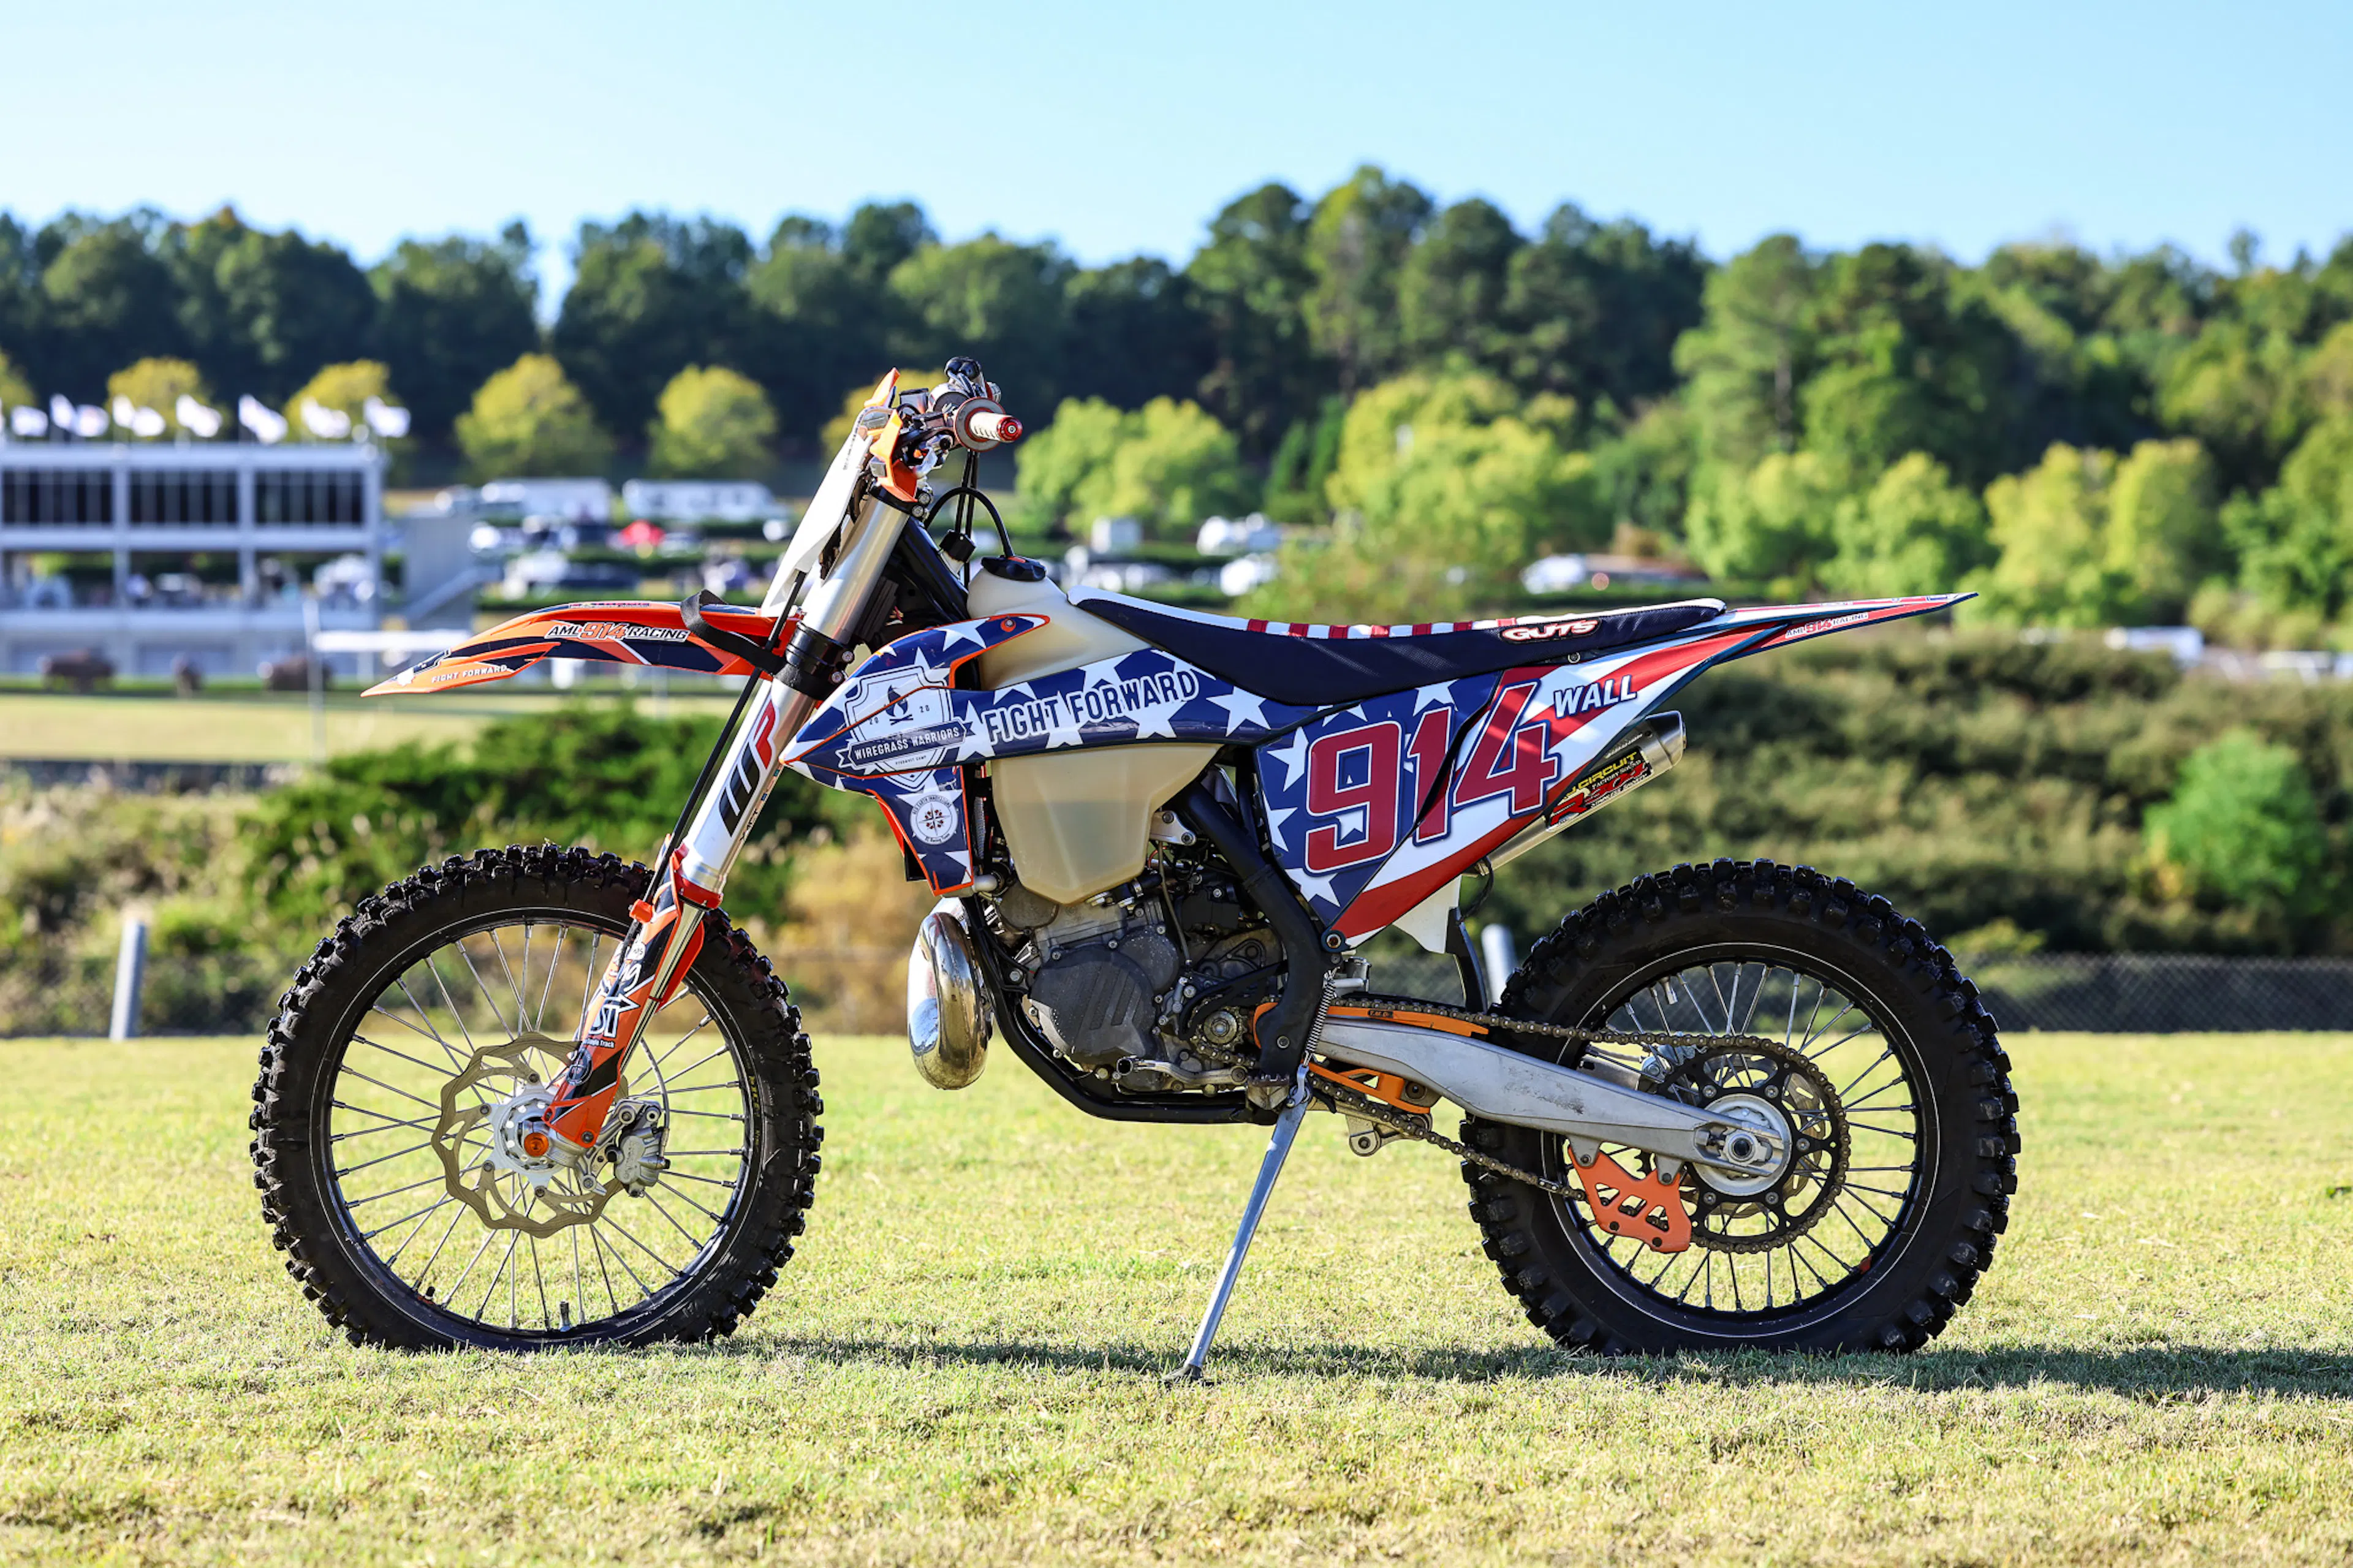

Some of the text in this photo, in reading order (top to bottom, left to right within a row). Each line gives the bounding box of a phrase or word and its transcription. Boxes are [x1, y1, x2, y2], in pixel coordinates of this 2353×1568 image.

[580, 623, 627, 639] 914
[628, 626, 690, 642] RACING
[1502, 620, 1598, 641] GUTS
[431, 664, 507, 683] FIGHT FORWARD
[981, 670, 1199, 743] FIGHT FORWARD
[1554, 675, 1637, 718] WALL
[854, 726, 960, 760] WIREGRASS WARRIORS
[1304, 678, 1562, 876] 914
[1578, 751, 1637, 790] CIRCUIT
